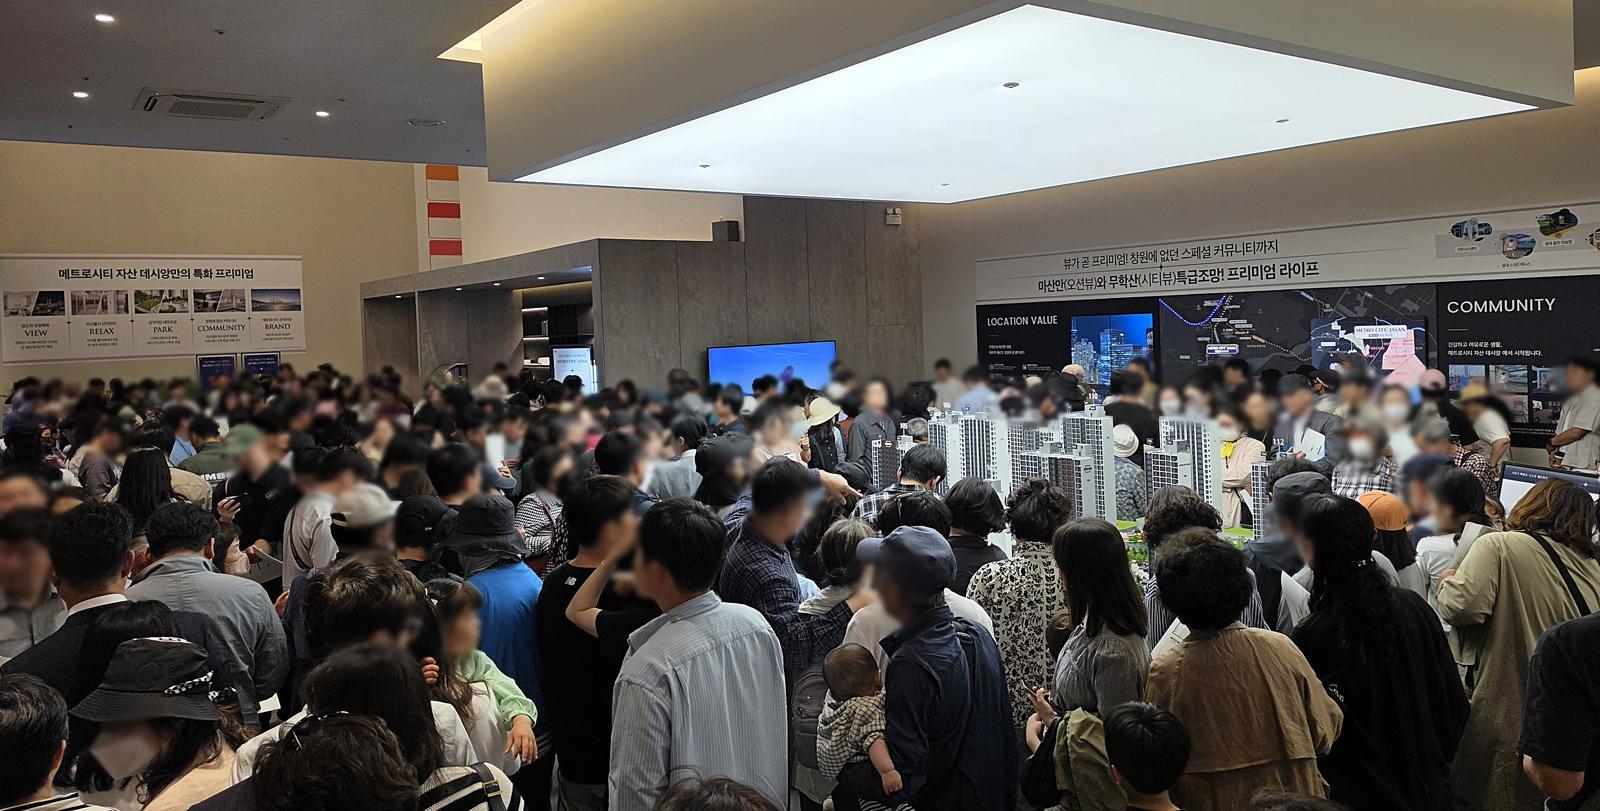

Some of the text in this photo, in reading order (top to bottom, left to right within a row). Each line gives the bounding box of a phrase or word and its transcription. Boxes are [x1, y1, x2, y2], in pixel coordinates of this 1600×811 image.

[1064, 239, 1279, 270] 뷰가 곧 프리미엄! 창원에 없던 스페셜 커뮤니티까지
[58, 268, 254, 280] 메트로시티 자산 데시앙만의 특화 프리미엄
[1038, 261, 1320, 293] 마산만(오션뷰)와 무학산(시티뷰)특급조망! 프리미엄 라이프
[1446, 298, 1556, 314] COMMUNITY
[987, 315, 1058, 326] LOCATION VALUE
[1272, 438, 1285, 446] 112
